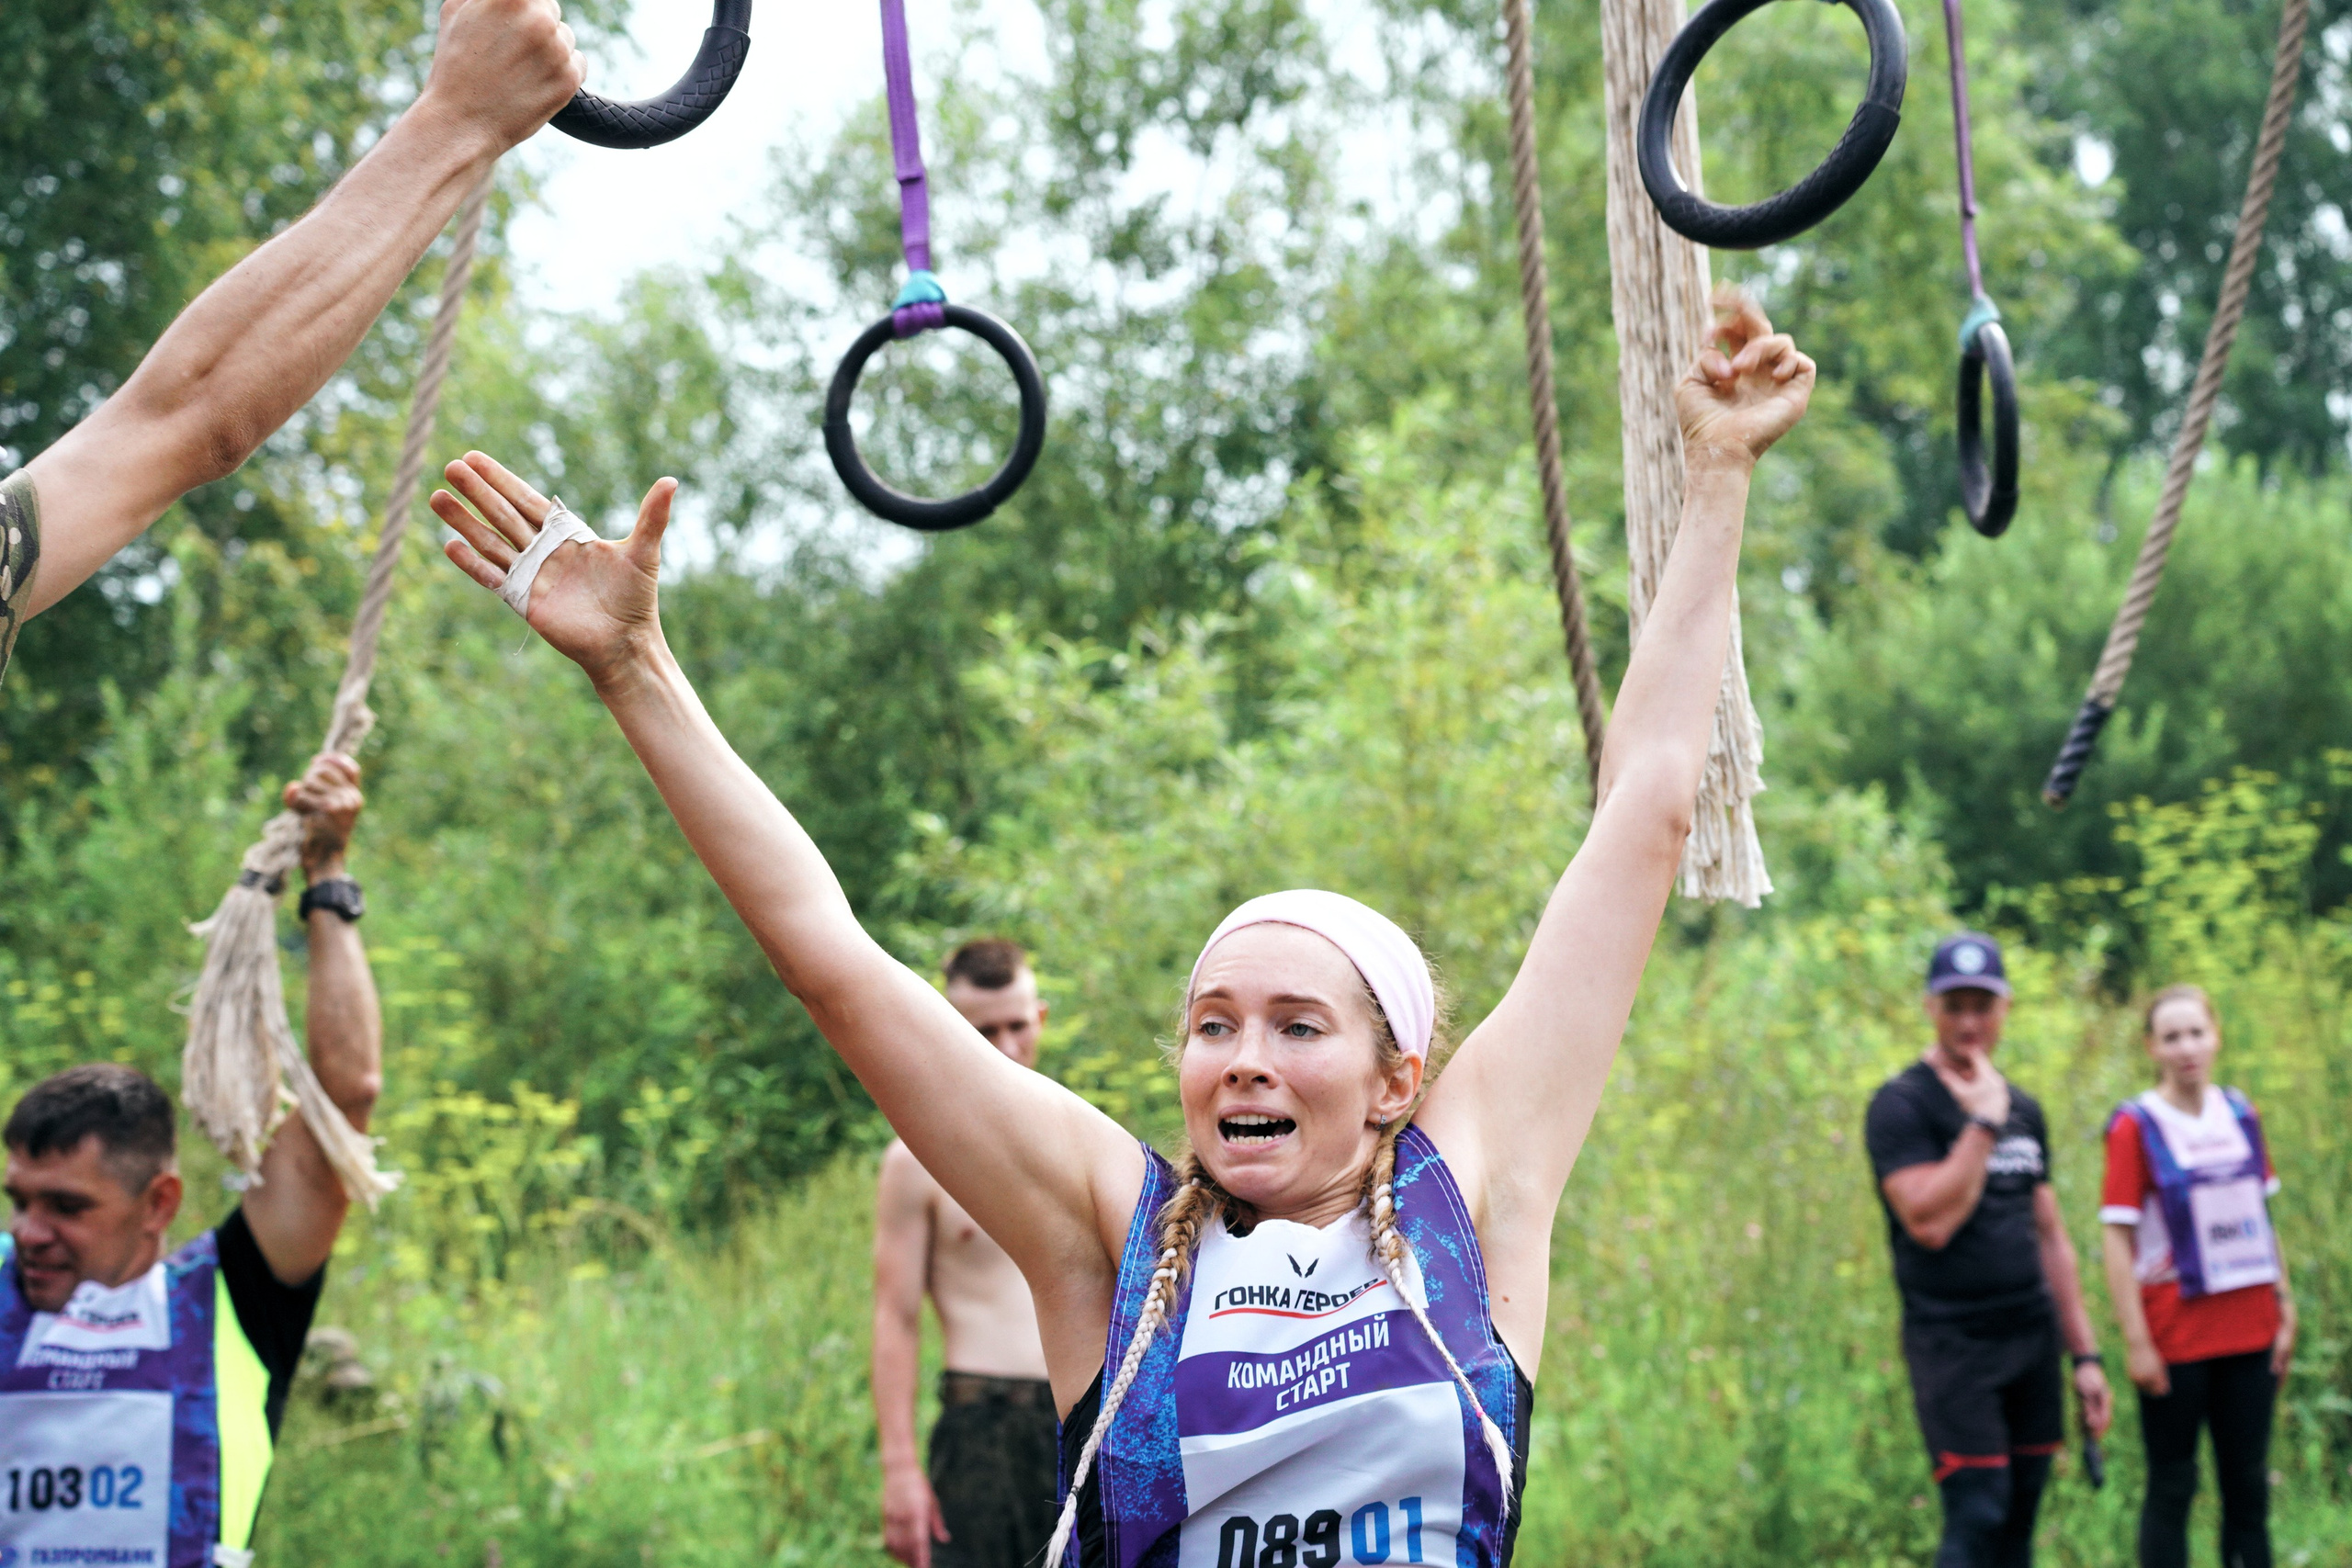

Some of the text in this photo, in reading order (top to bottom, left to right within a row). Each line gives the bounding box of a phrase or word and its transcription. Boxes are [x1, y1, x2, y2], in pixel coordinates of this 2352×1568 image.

[1215, 1285, 1291, 1310] ГОНКА
[1227, 1314, 1389, 1389] КОМАНДНЫЙ
[1276, 1361, 1351, 1411] СТАРТ
[8, 1465, 143, 1512] 10302
[1217, 1496, 1423, 1568] 08901
